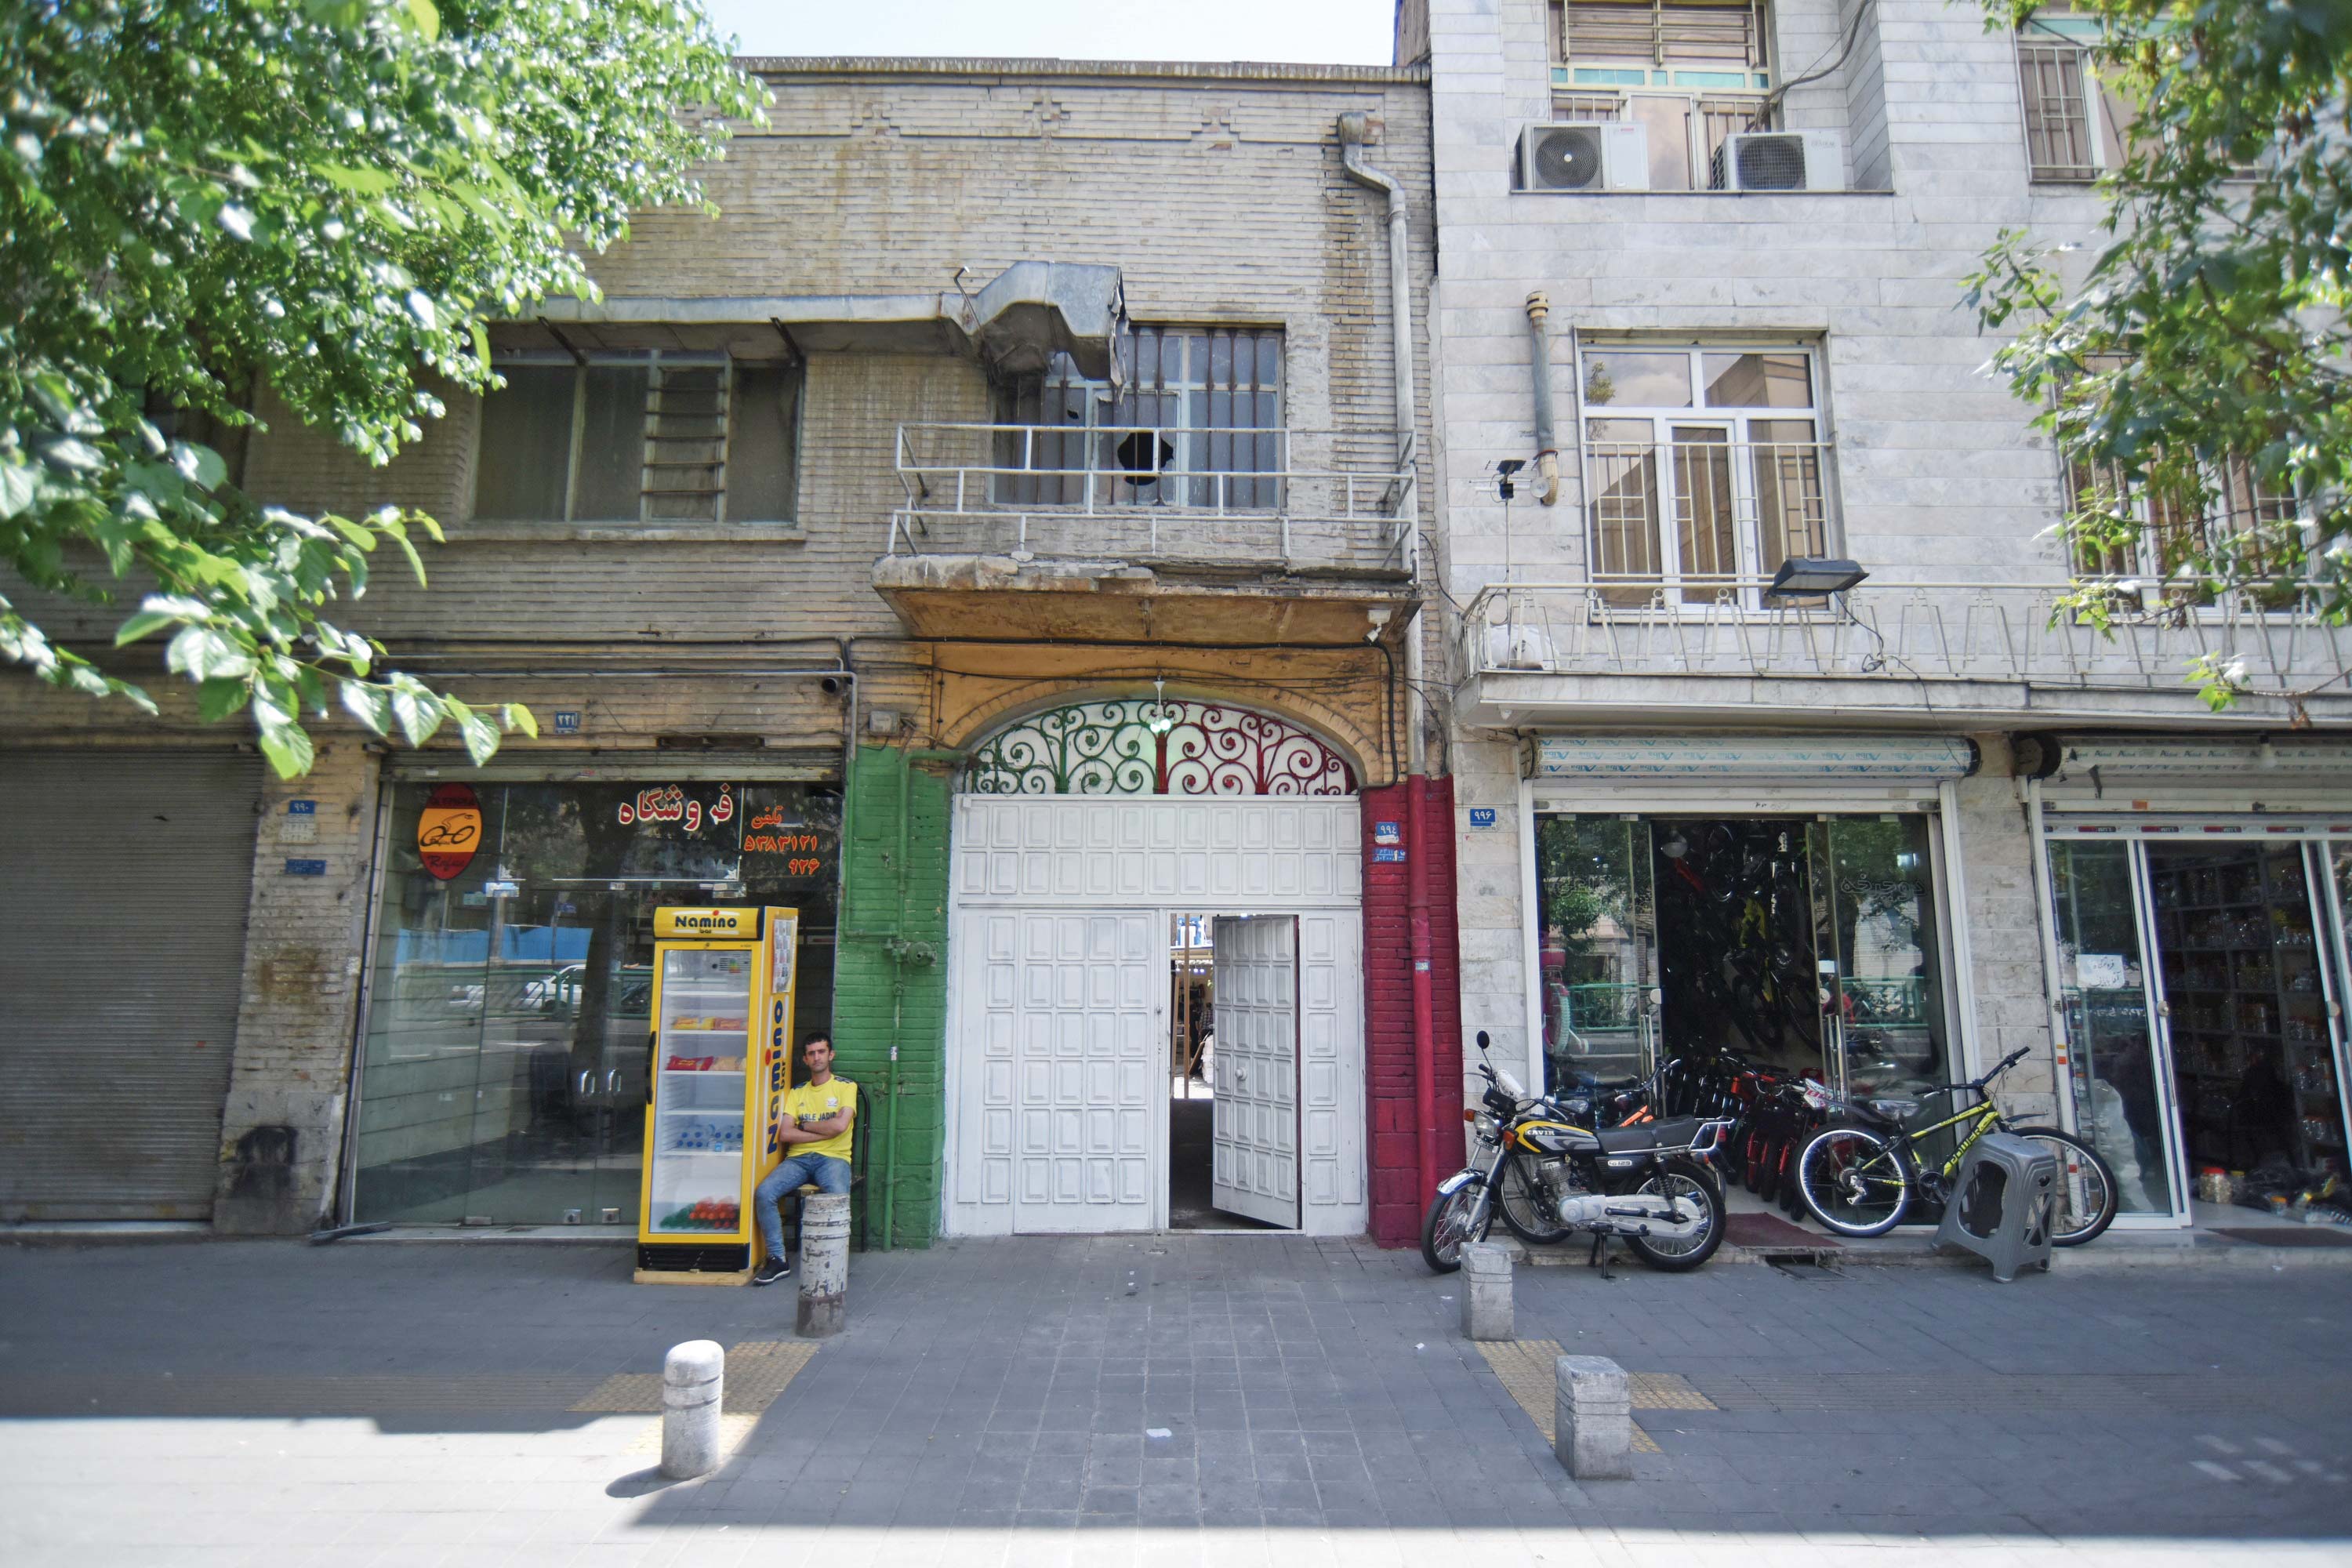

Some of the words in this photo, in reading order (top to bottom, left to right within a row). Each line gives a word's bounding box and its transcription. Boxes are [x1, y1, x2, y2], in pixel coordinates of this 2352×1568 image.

[618, 782, 734, 831] فروشگاه
[751, 804, 783, 829] تلفن
[675, 909, 738, 928] Namino
[765, 1000, 783, 1155] Namino
